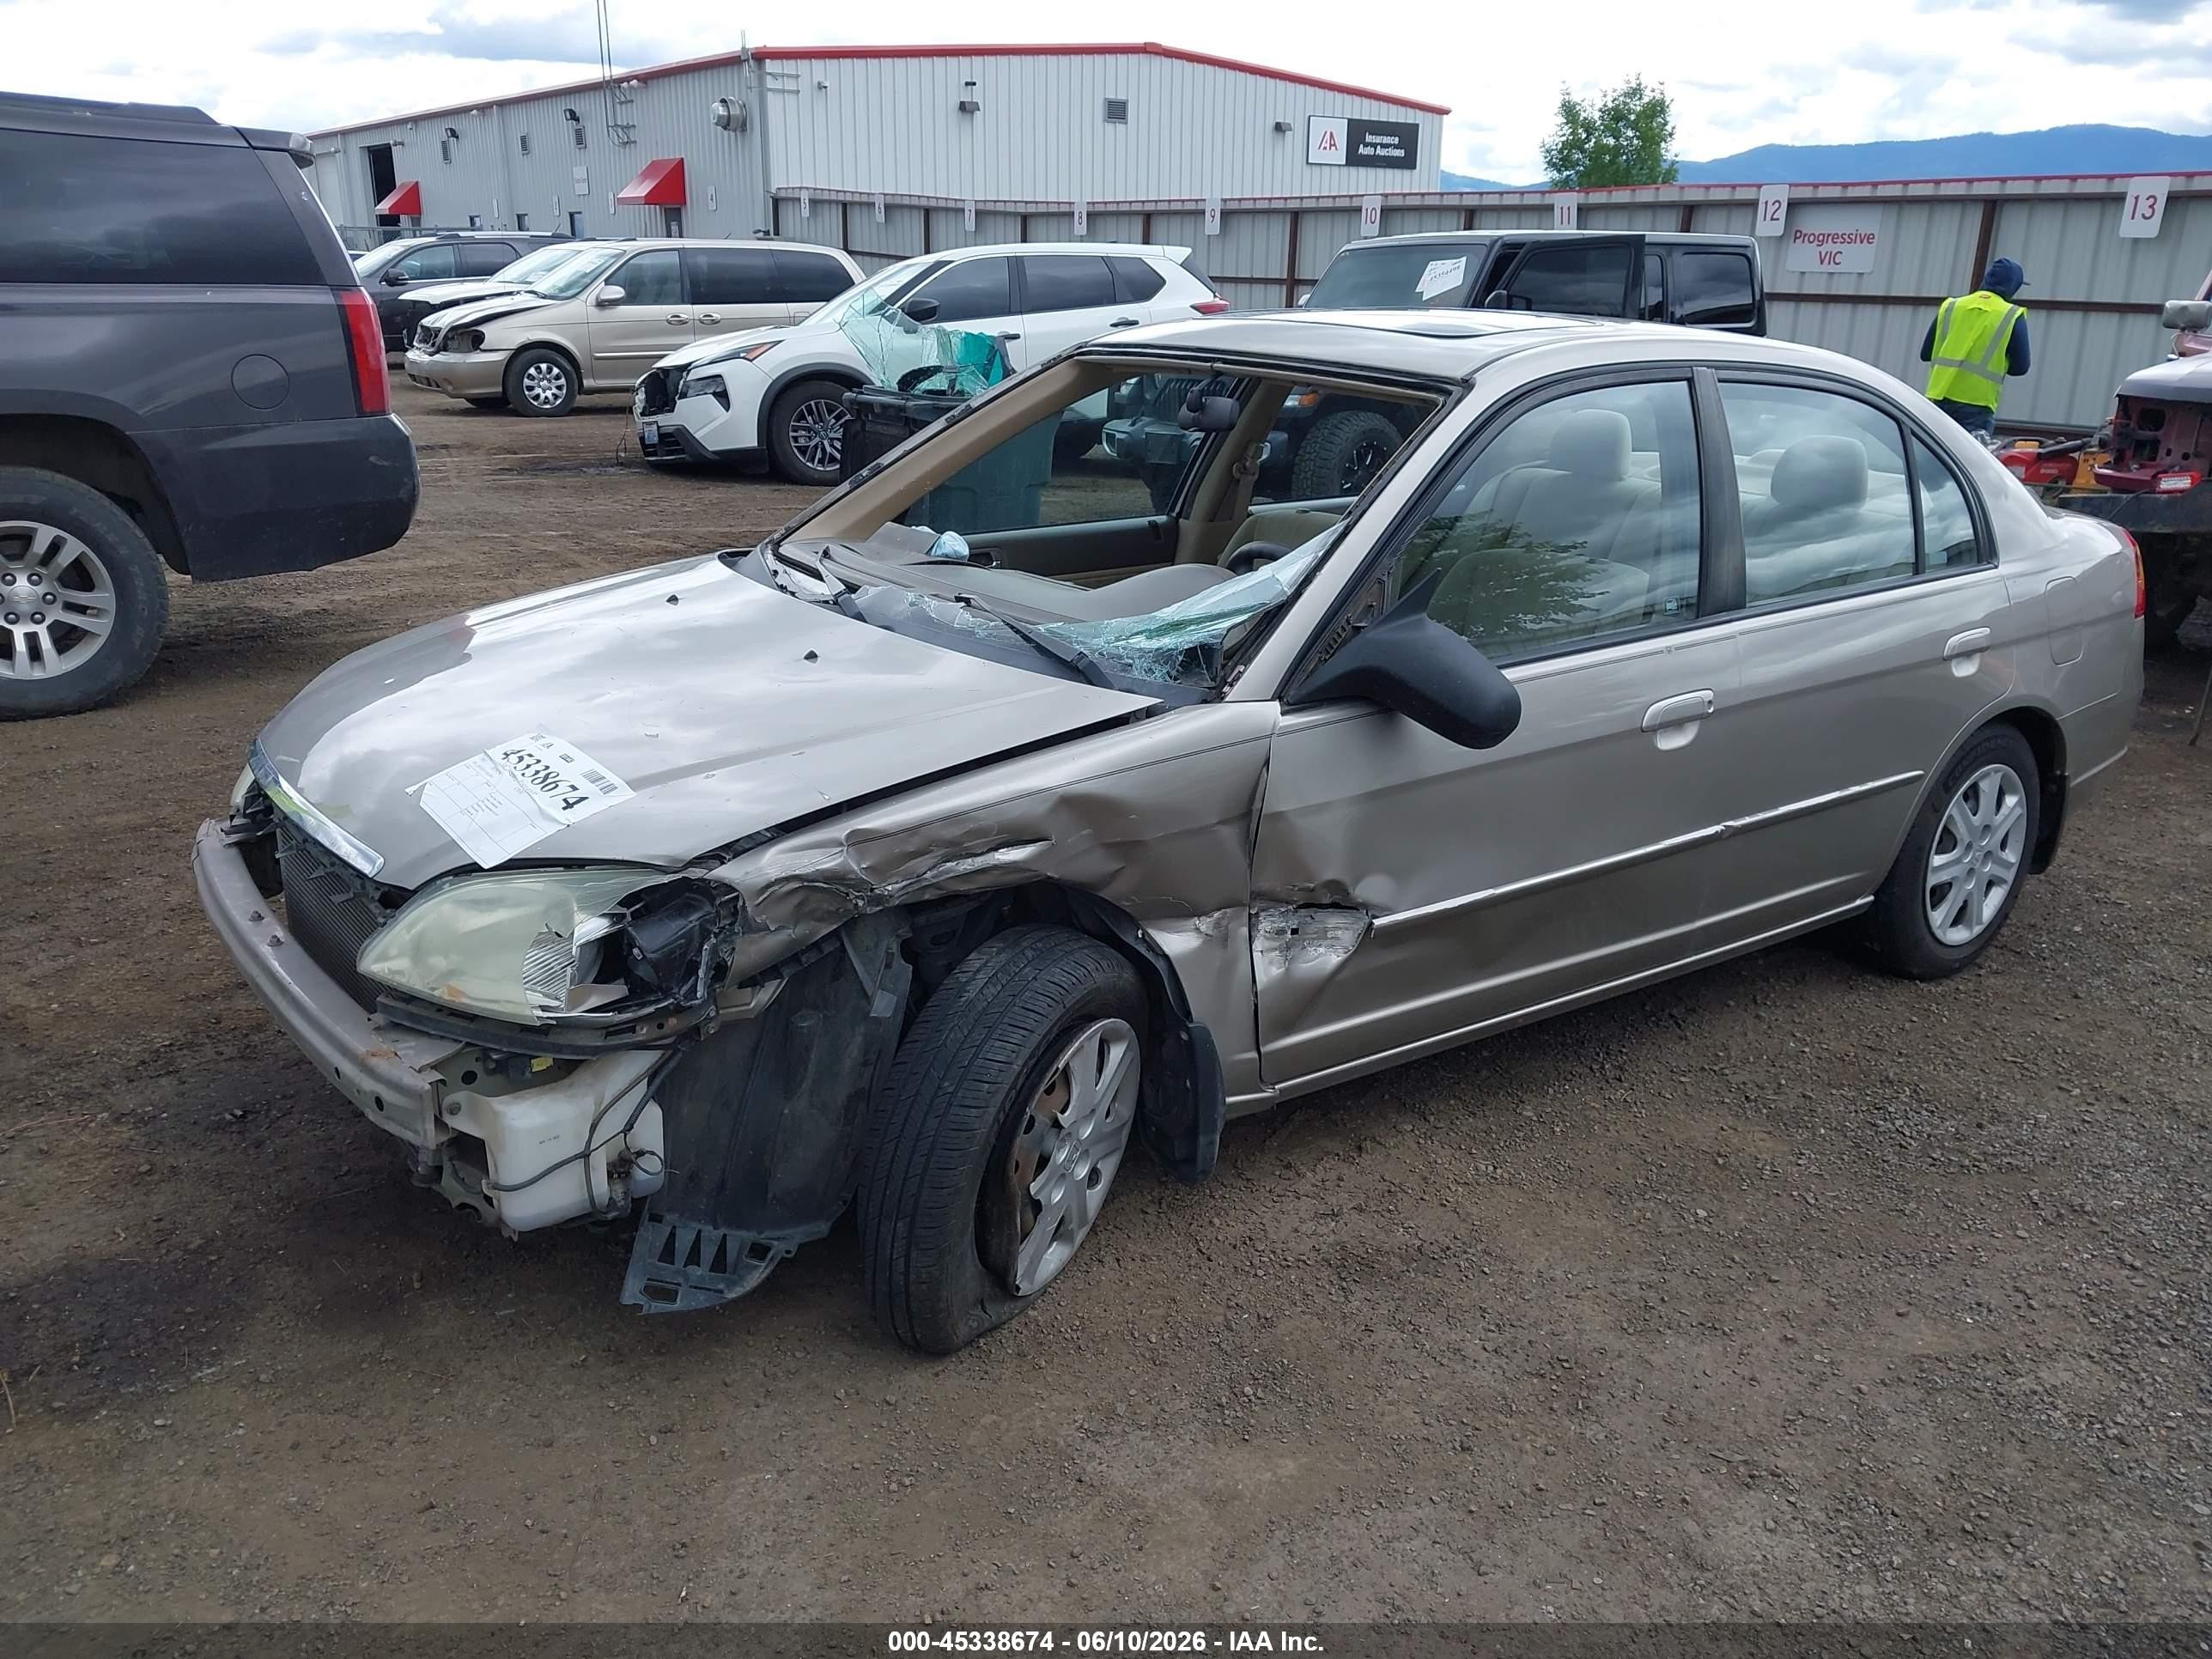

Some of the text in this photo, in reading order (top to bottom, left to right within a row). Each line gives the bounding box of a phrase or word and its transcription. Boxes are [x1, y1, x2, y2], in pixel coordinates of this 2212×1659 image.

[1365, 131, 1399, 144] Insurance
[1358, 143, 1405, 157] Auto Auctions
[803, 198, 807, 210] 5
[878, 203, 882, 214] 6
[1762, 199, 1782, 222] 12
[2130, 194, 2158, 221] 13
[968, 209, 972, 222] 7
[1078, 211, 1083, 226] 8
[1210, 208, 1216, 223] 9
[1364, 208, 1377, 224] 10
[1559, 205, 1571, 226] 11
[1793, 228, 1875, 246] Progressive
[1819, 251, 1843, 265] VIC
[501, 749, 589, 811] 45338674
